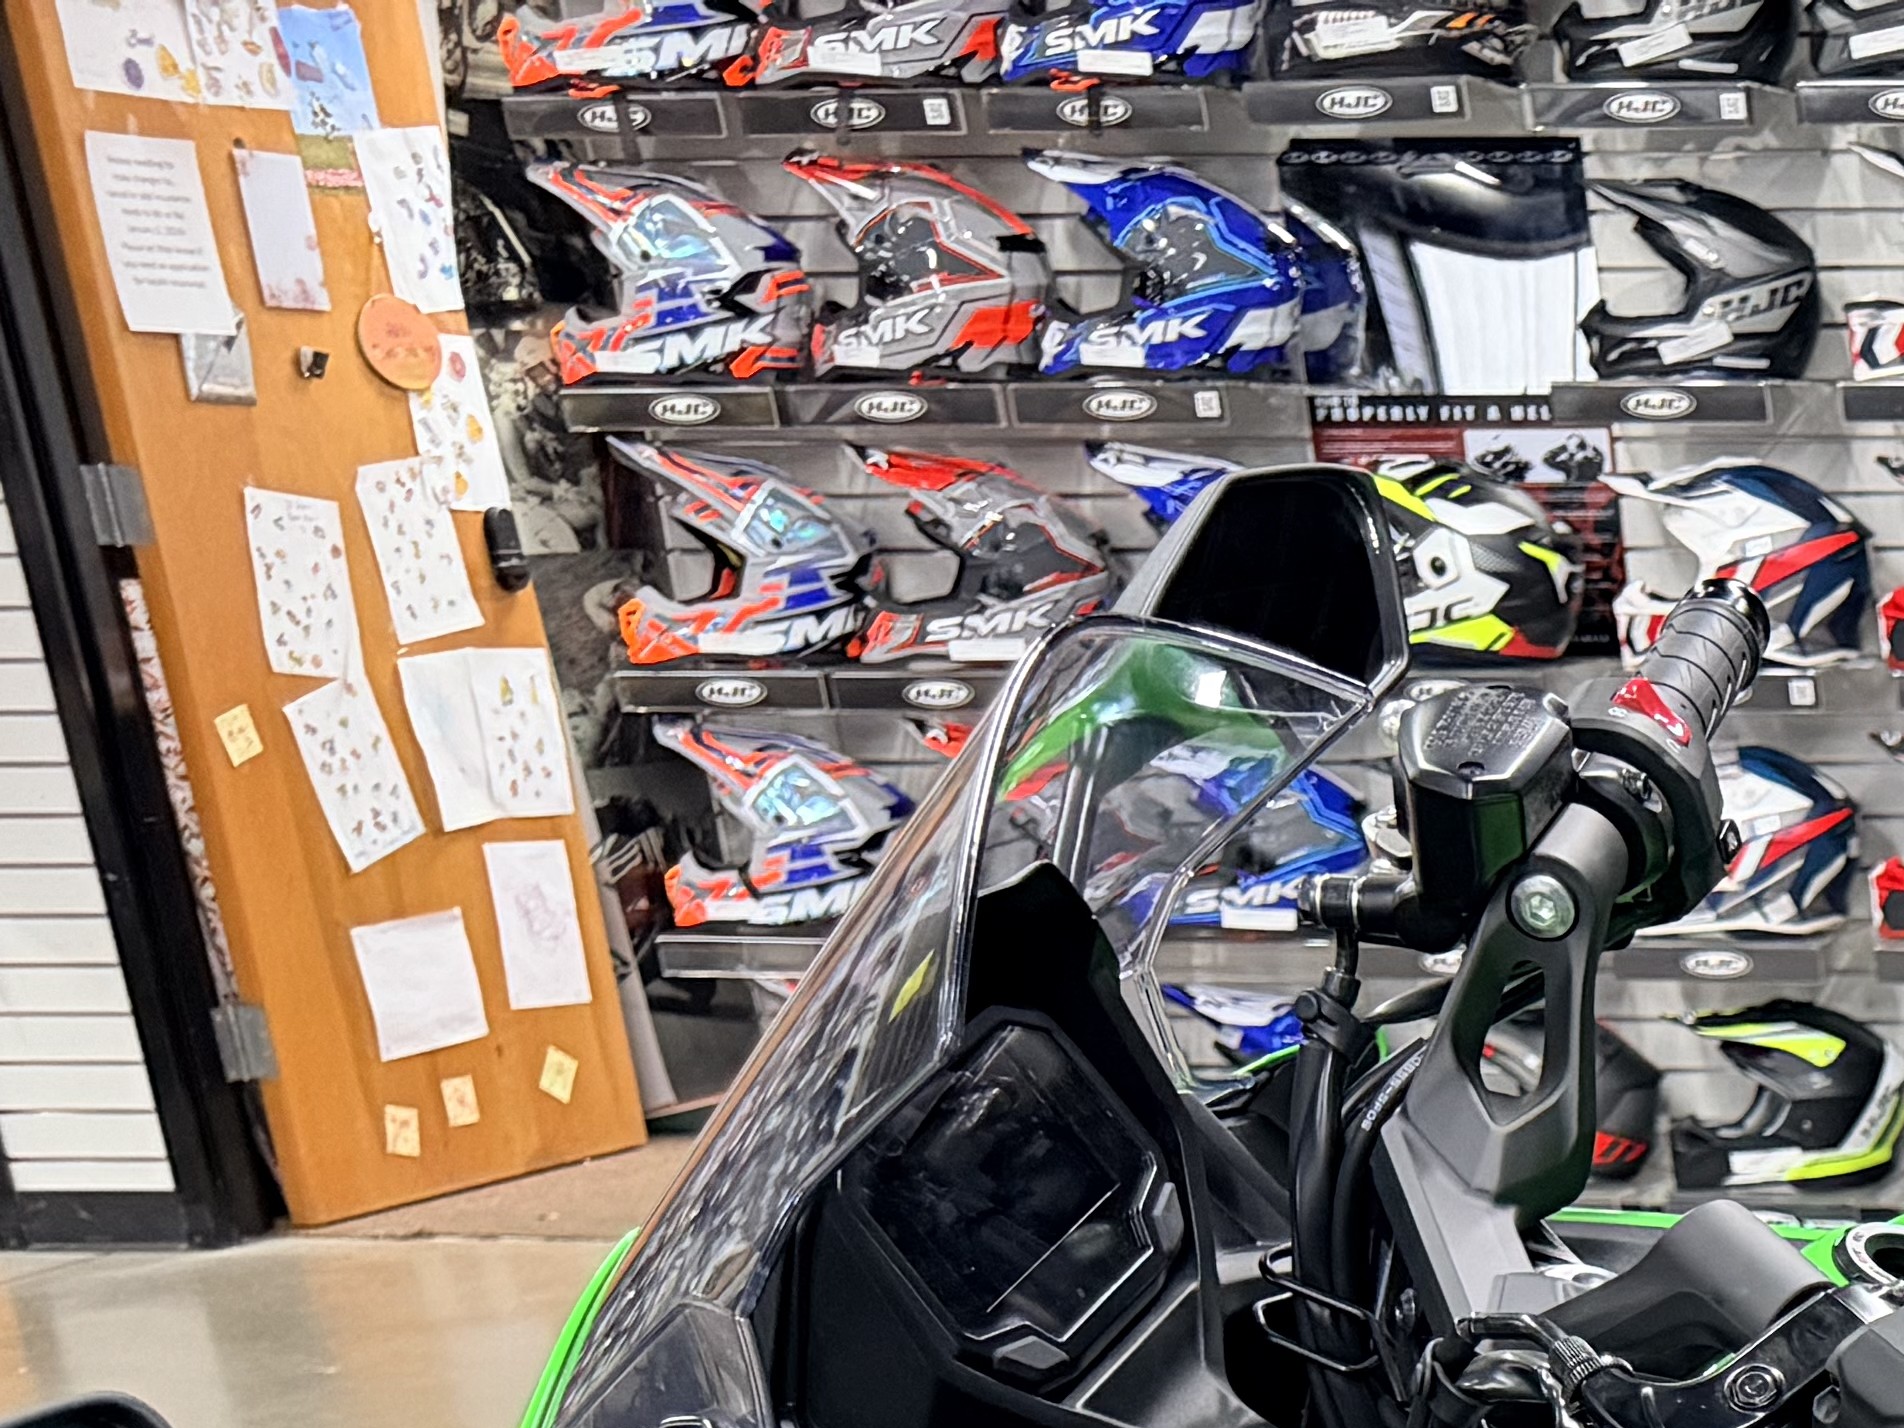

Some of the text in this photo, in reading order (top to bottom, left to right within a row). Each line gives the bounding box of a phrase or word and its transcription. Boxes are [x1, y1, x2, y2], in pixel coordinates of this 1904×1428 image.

[813, 18, 947, 52] SMK
[1044, 8, 1161, 56] SMK
[837, 307, 936, 350] SMK
[1086, 311, 1208, 349] SMK
[924, 603, 1051, 643] SMK
